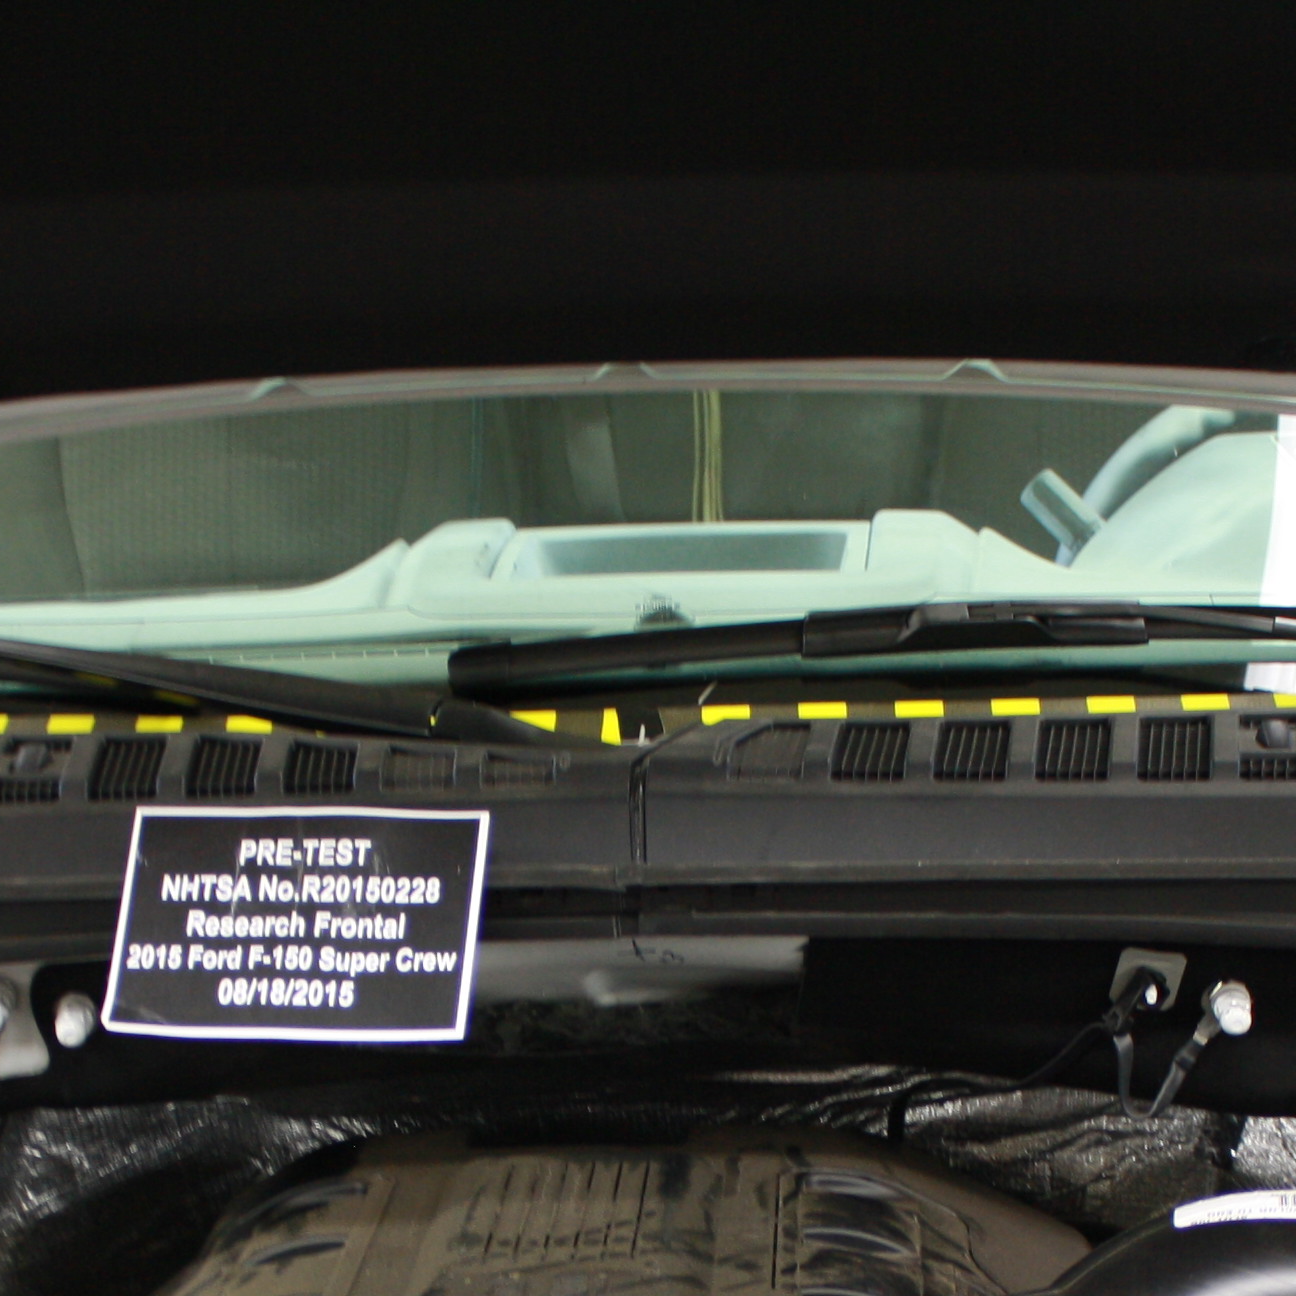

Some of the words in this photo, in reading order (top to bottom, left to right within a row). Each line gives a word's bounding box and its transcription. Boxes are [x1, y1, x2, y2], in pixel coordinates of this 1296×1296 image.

[239, 838, 372, 867] PRE-TEST
[161, 874, 252, 903] NHTSA
[186, 909, 305, 939] Research
[313, 911, 407, 940] Frontal
[126, 943, 182, 970] 2015
[188, 944, 243, 971] Ford
[248, 945, 313, 972] F-150
[319, 946, 391, 977] Super
[395, 947, 458, 973] Crew
[217, 978, 355, 1008] 08/18/2015
